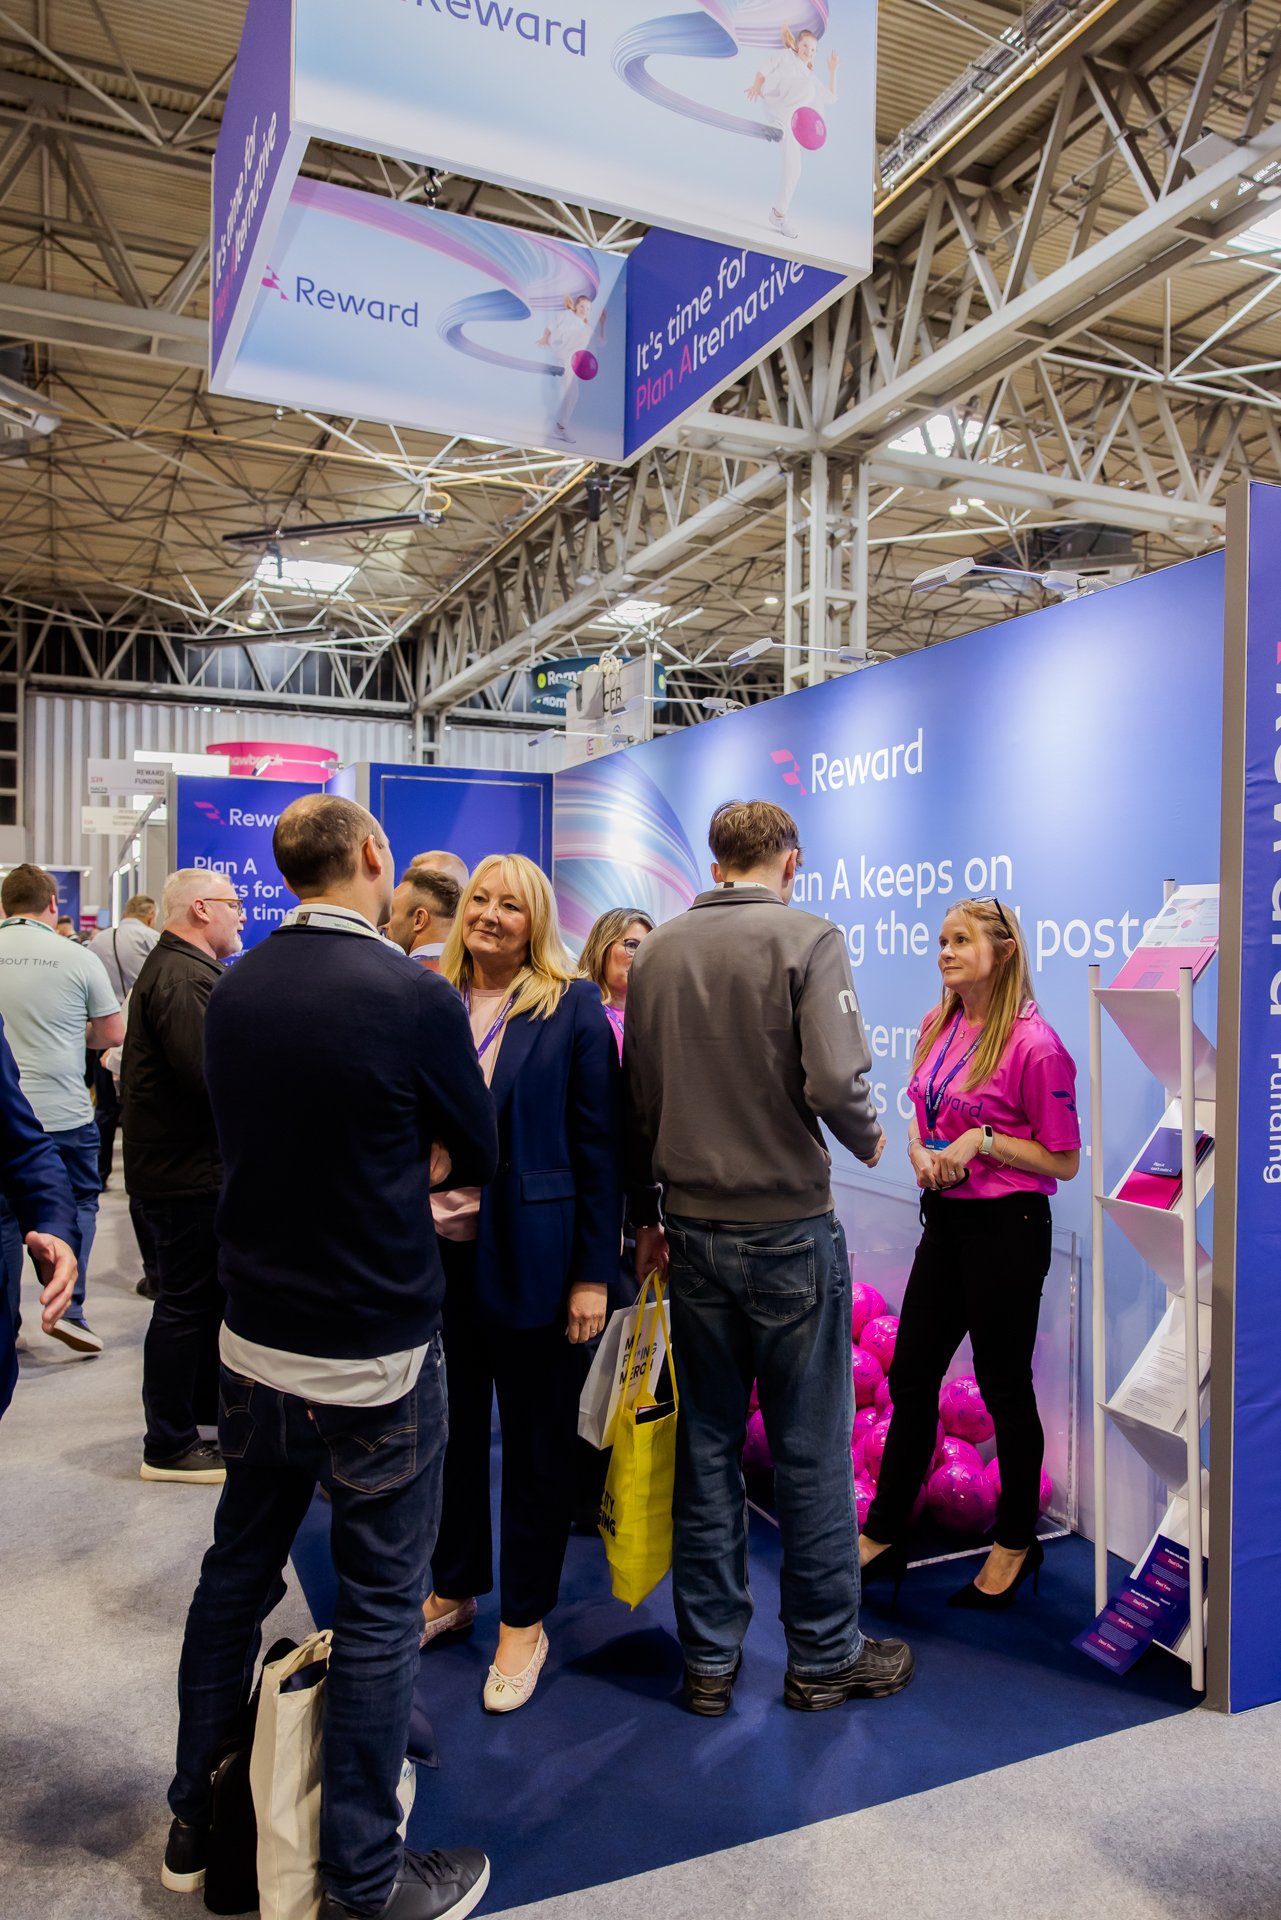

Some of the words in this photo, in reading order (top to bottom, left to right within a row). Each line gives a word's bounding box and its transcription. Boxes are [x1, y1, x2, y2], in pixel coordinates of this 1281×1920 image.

[295, 275, 420, 329] Reward
[636, 331, 663, 377] It's
[667, 285, 713, 346] time
[717, 250, 749, 300] for
[635, 367, 674, 421] Plan
[678, 260, 805, 384] Alternative
[547, 670, 582, 687] Rom
[811, 727, 923, 794] Reward
[134, 778, 165, 786] FUNDING
[136, 768, 165, 777] REWARD
[229, 808, 281, 828] Rew
[194, 856, 238, 875] Plan
[242, 858, 258, 875] A
[253, 880, 284, 899] for
[792, 869, 823, 902] an
[830, 858, 852, 900] A
[860, 854, 954, 908] keeps
[964, 853, 1013, 892] on
[874, 910, 930, 956] the
[33, 957, 60, 969] TIME
[941, 1094, 983, 1119] ward
